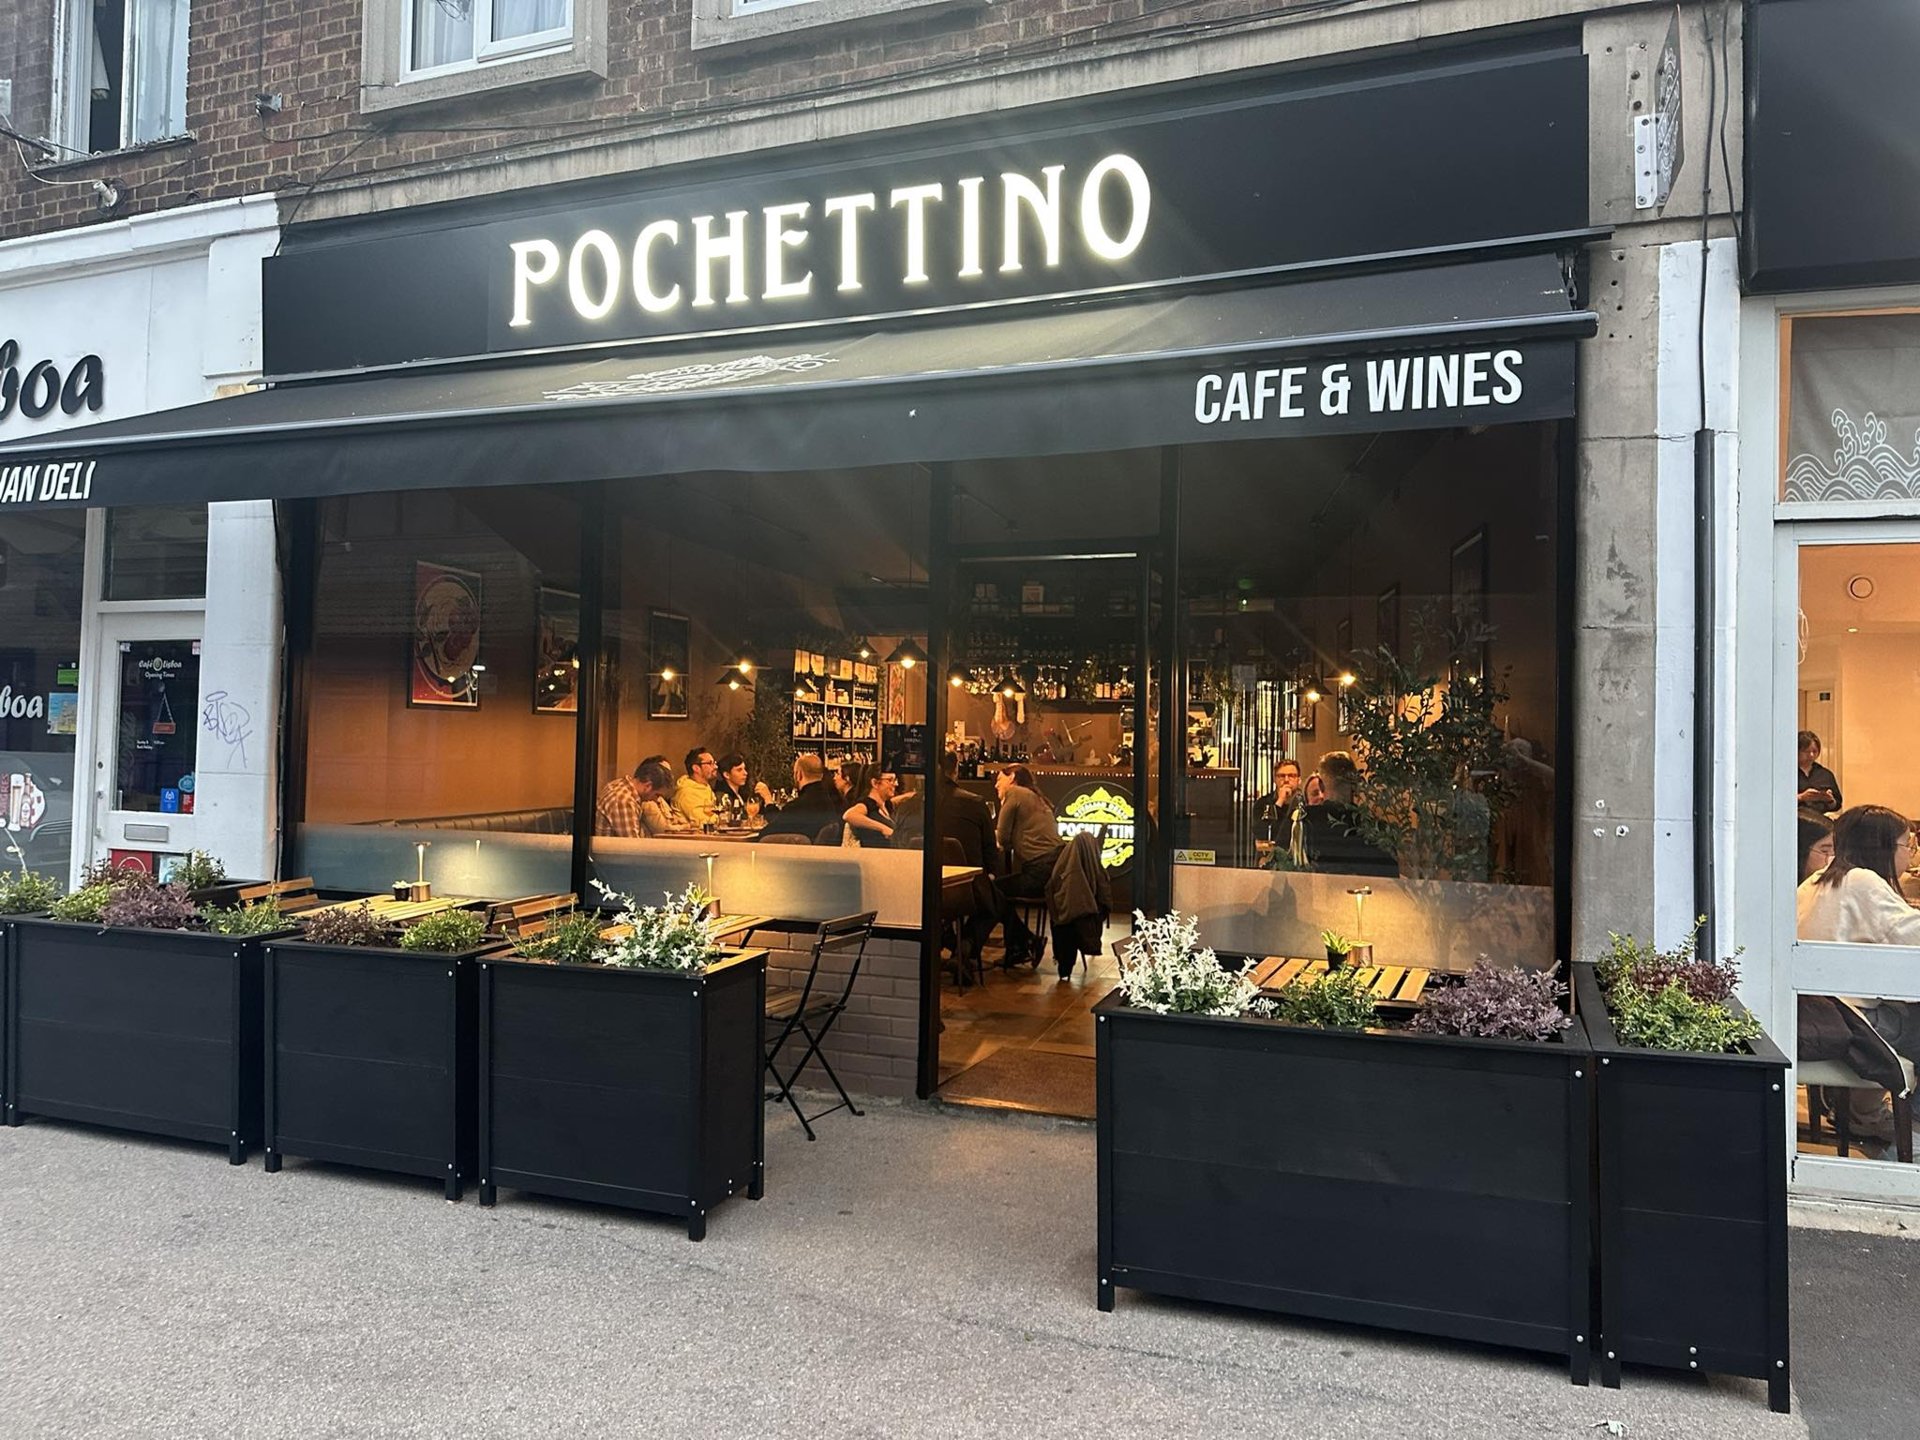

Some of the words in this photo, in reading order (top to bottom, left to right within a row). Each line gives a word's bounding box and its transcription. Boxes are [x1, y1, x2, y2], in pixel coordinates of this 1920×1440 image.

[508, 153, 1153, 328] POCHETTINO
[1194, 365, 1308, 424] CAFE
[1319, 363, 1352, 416] &
[1366, 349, 1524, 413] WINES
[39, 460, 97, 501] DELI
